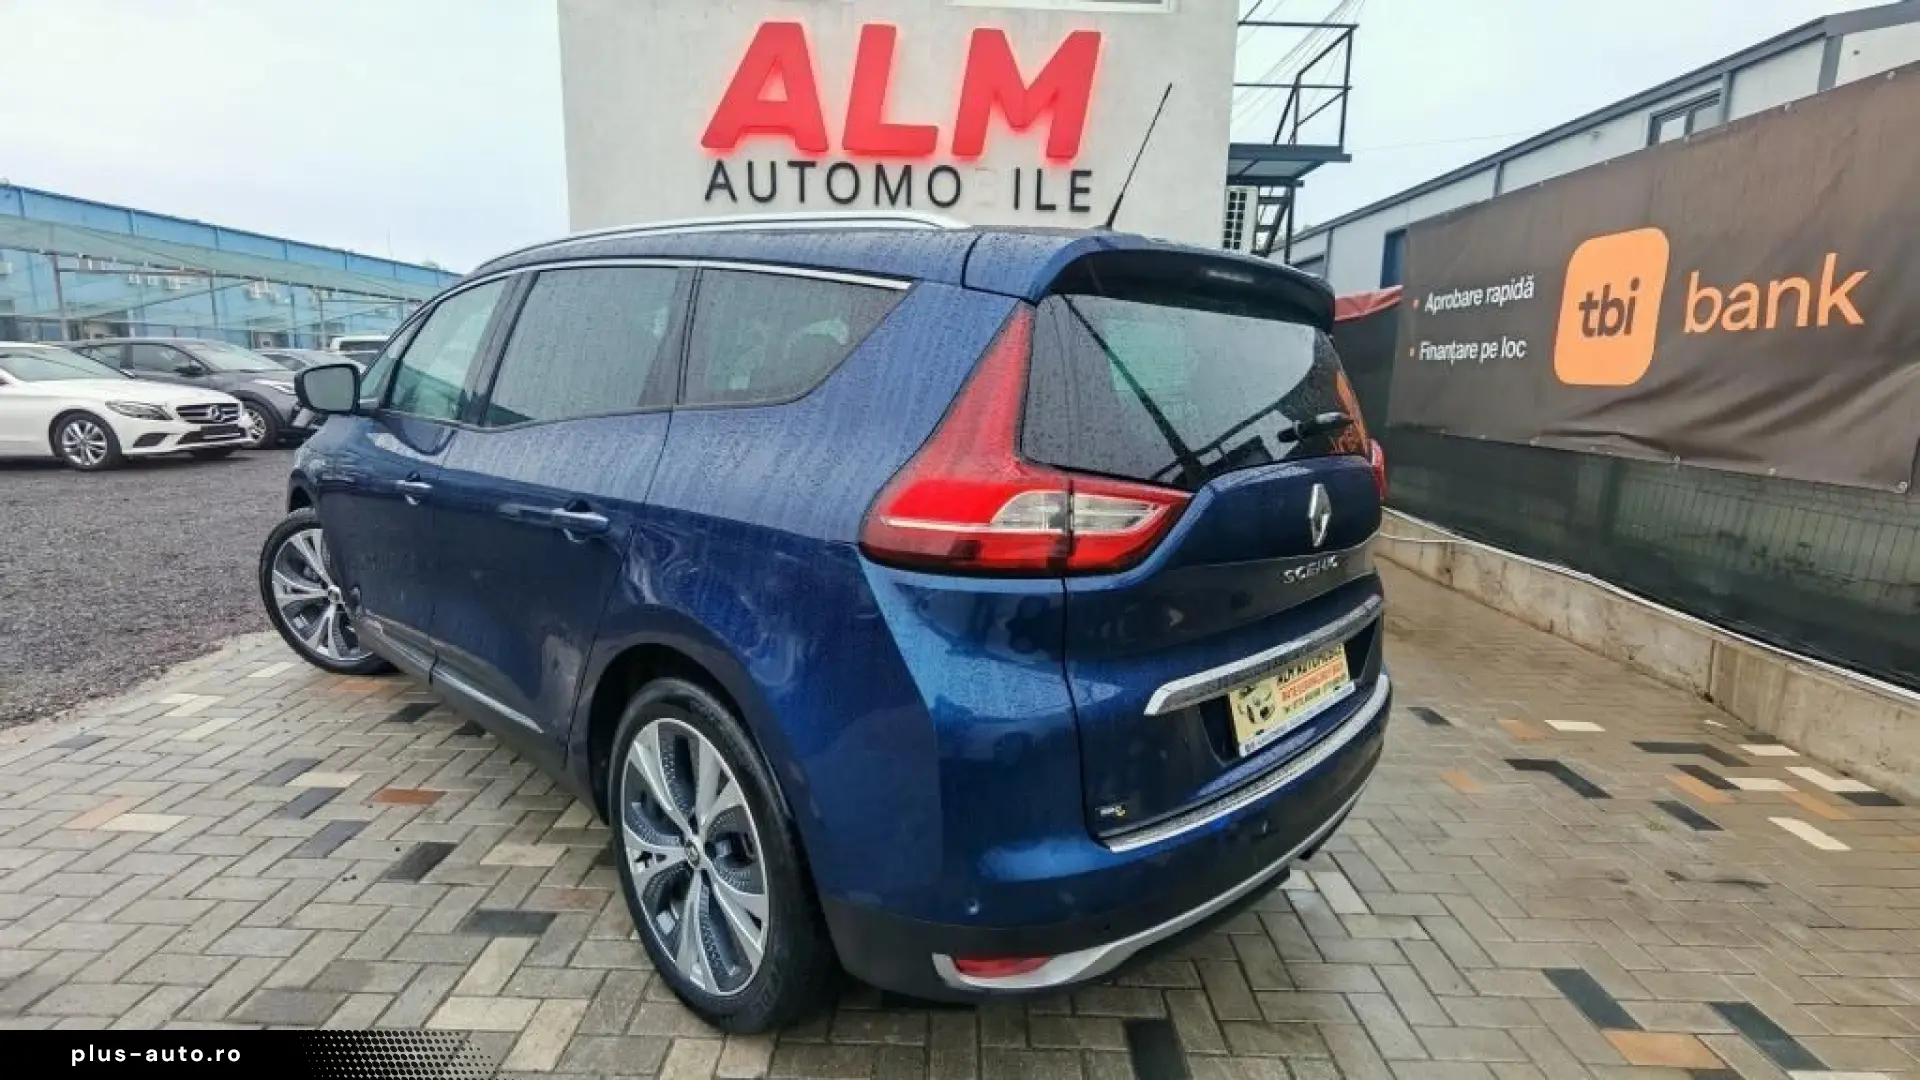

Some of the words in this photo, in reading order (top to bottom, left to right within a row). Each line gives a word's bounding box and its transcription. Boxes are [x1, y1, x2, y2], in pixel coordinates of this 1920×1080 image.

[701, 22, 1101, 159] ALM
[705, 160, 1093, 212] AUTOMOILE
[1424, 288, 1484, 316] Aprobare
[1486, 272, 1535, 308] rapidă
[1578, 276, 1641, 338] tbi
[1684, 252, 1871, 333] bank
[1479, 342, 1499, 364] pe
[1501, 335, 1527, 359] loc
